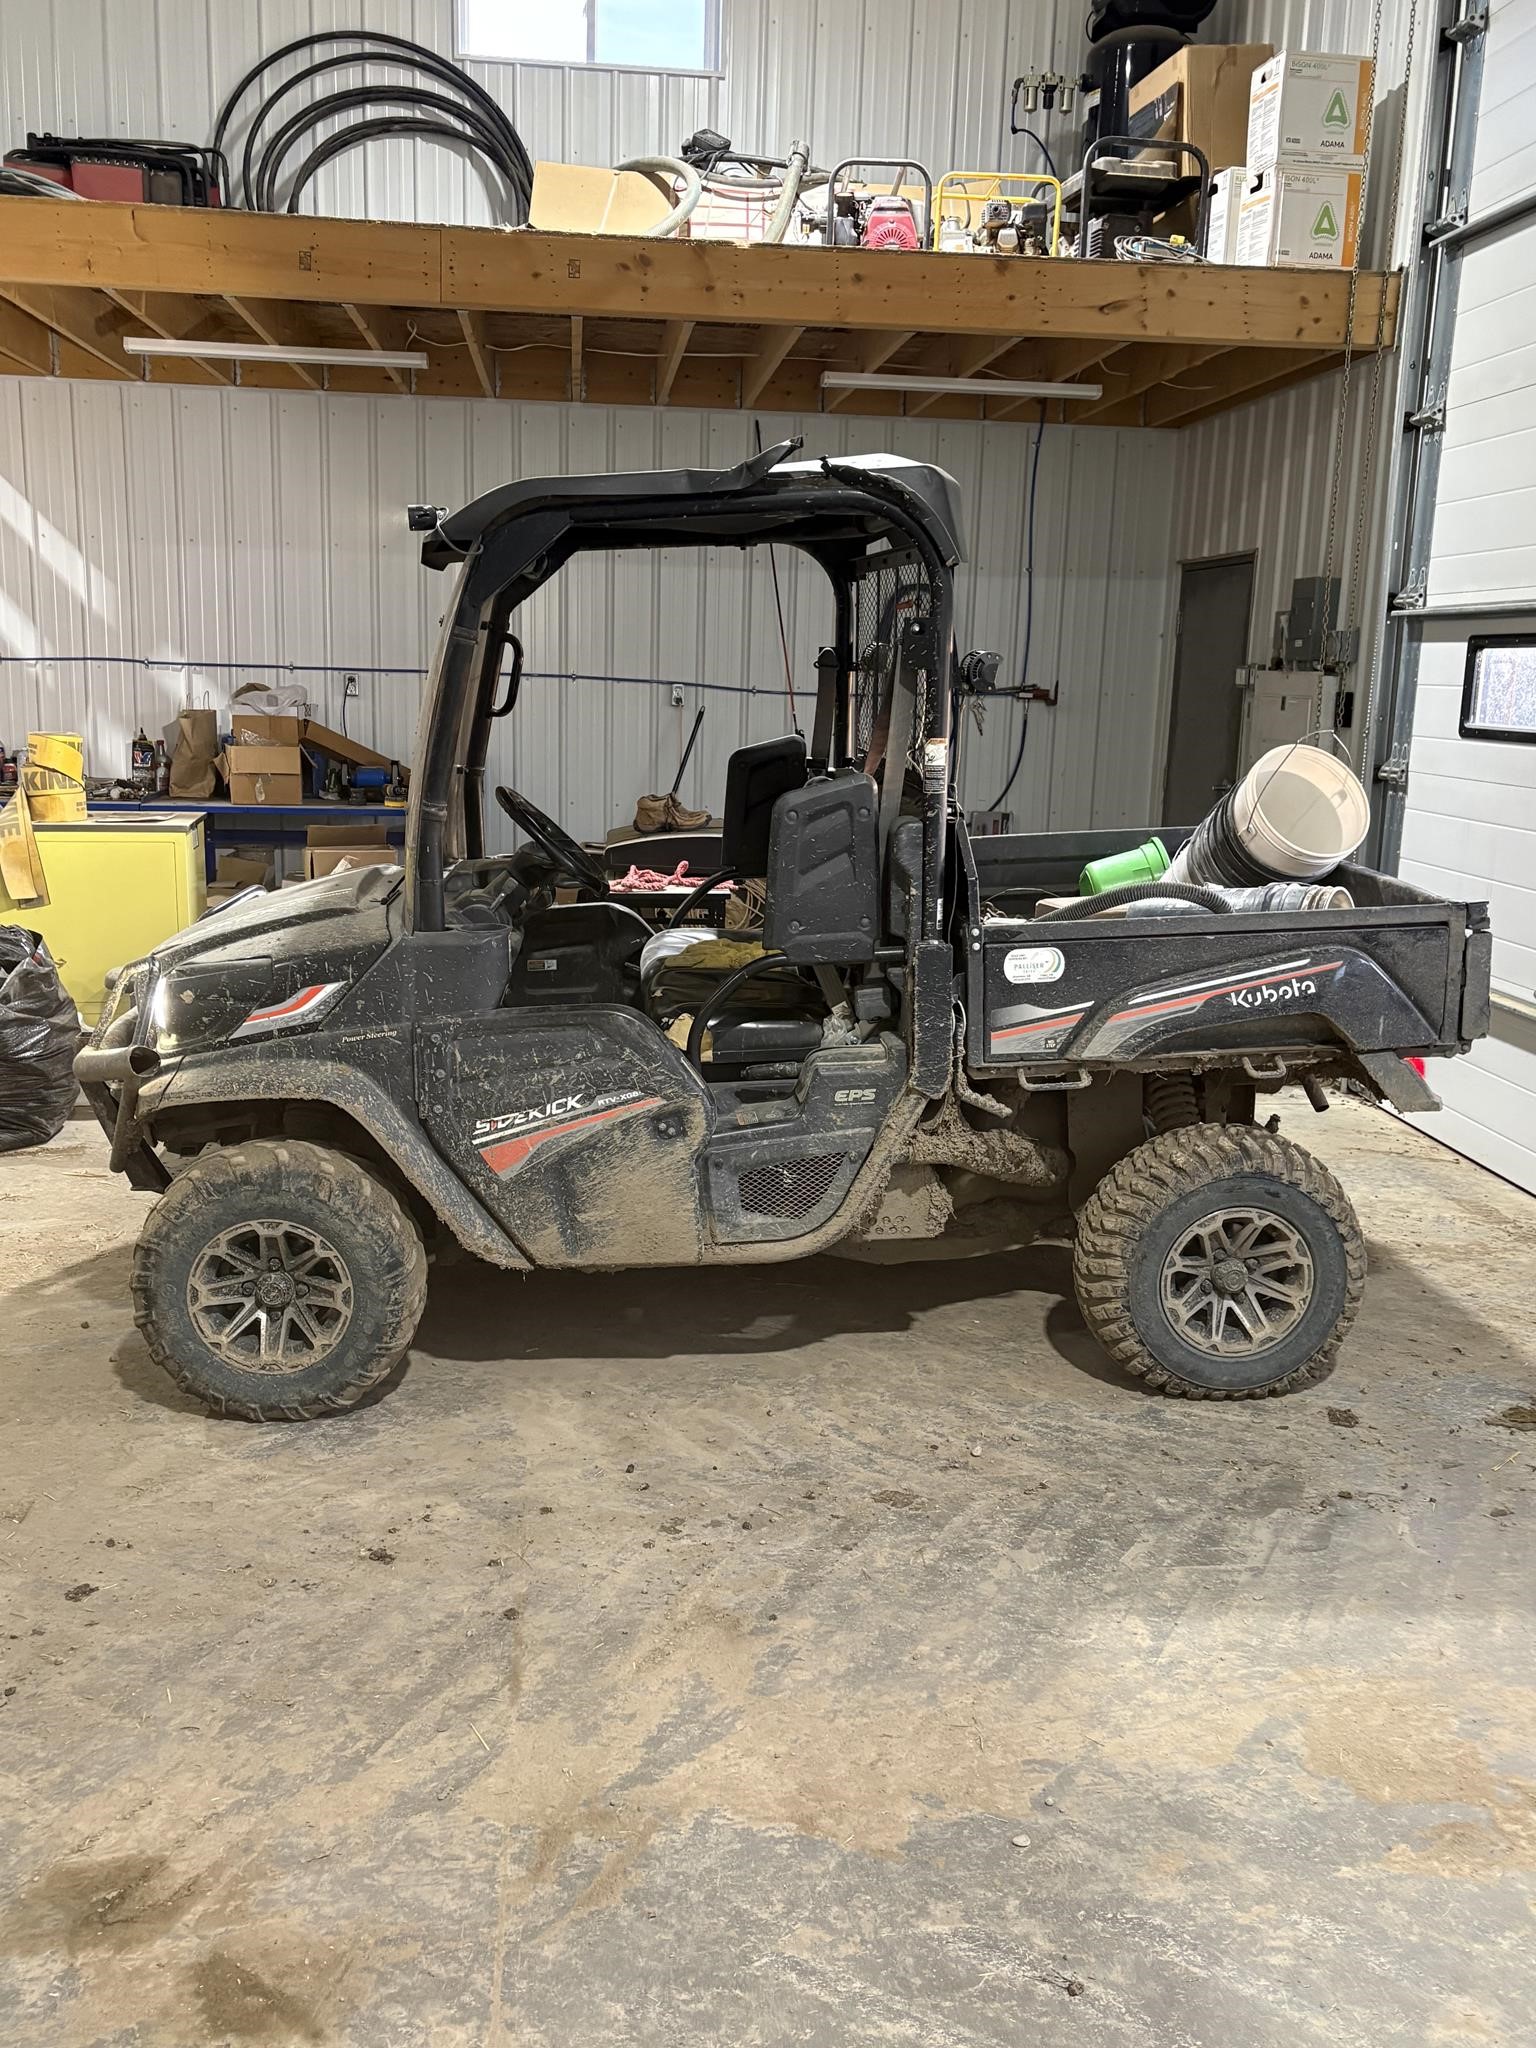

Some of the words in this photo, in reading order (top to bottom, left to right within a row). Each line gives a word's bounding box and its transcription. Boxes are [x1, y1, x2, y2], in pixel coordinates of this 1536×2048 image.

[1320, 140, 1345, 148] ADAMA
[1308, 252, 1333, 260] ADAMA
[1230, 978, 1317, 1008] Kubota
[342, 1034, 365, 1043] Power
[366, 1030, 398, 1040] Steering
[834, 1088, 877, 1102] EPS
[472, 1093, 584, 1135] SIDEKICK
